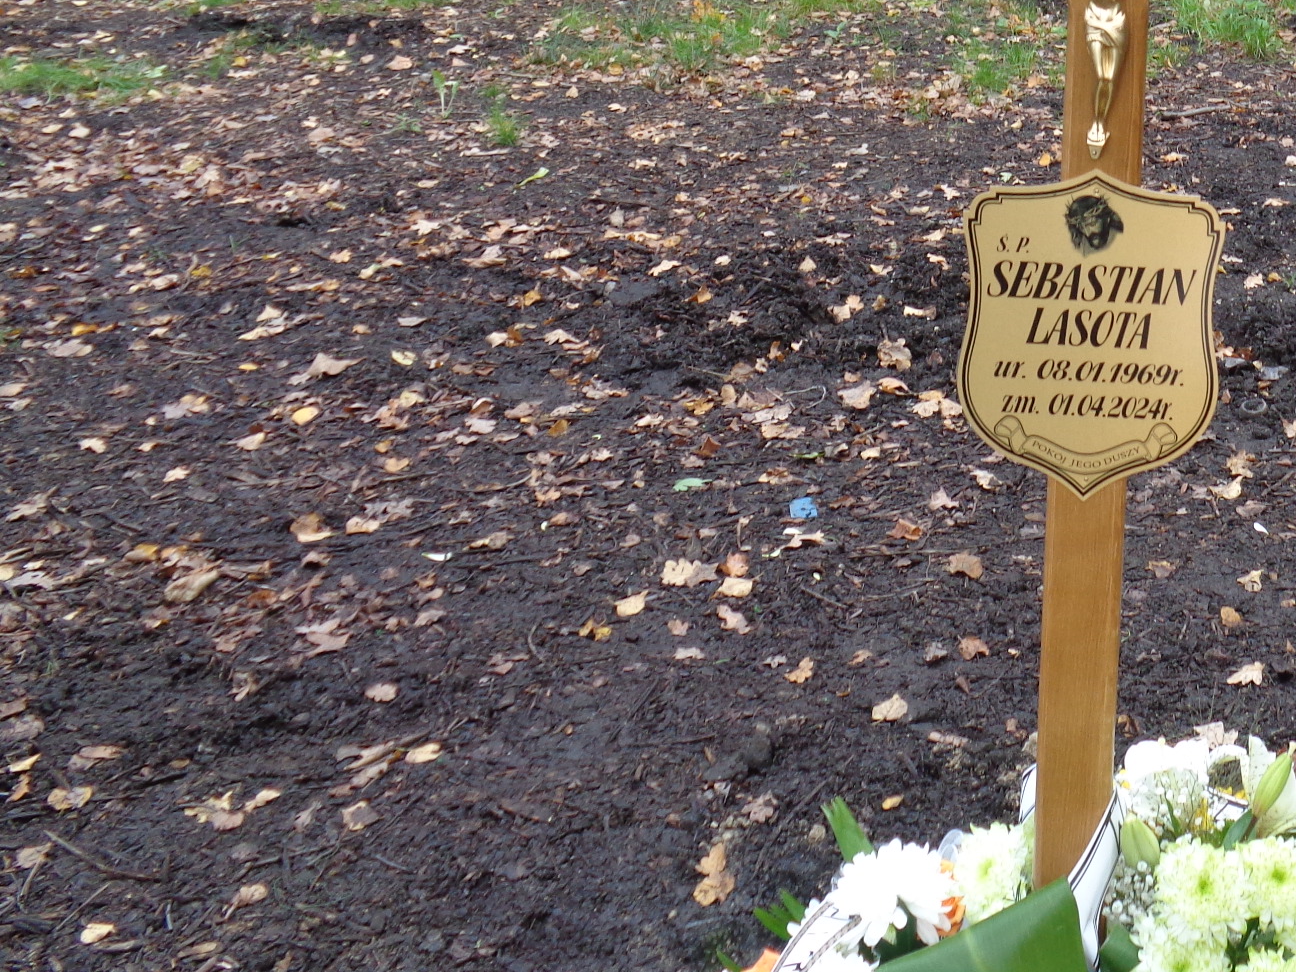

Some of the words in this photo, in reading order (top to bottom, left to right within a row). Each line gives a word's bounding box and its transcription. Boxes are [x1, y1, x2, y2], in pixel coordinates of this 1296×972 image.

[1016, 237, 1029, 253] P.
[987, 260, 1197, 306] SEBASTIAN
[1026, 307, 1151, 350] LASOTA
[994, 361, 1025, 378] ur.
[1037, 358, 1184, 386] 08.01.1969r.
[1001, 395, 1039, 414] zm.
[1048, 393, 1172, 420] 01.04.2024r.
[1070, 459, 1101, 468] JEGO
[1104, 446, 1140, 465] DUSZY
